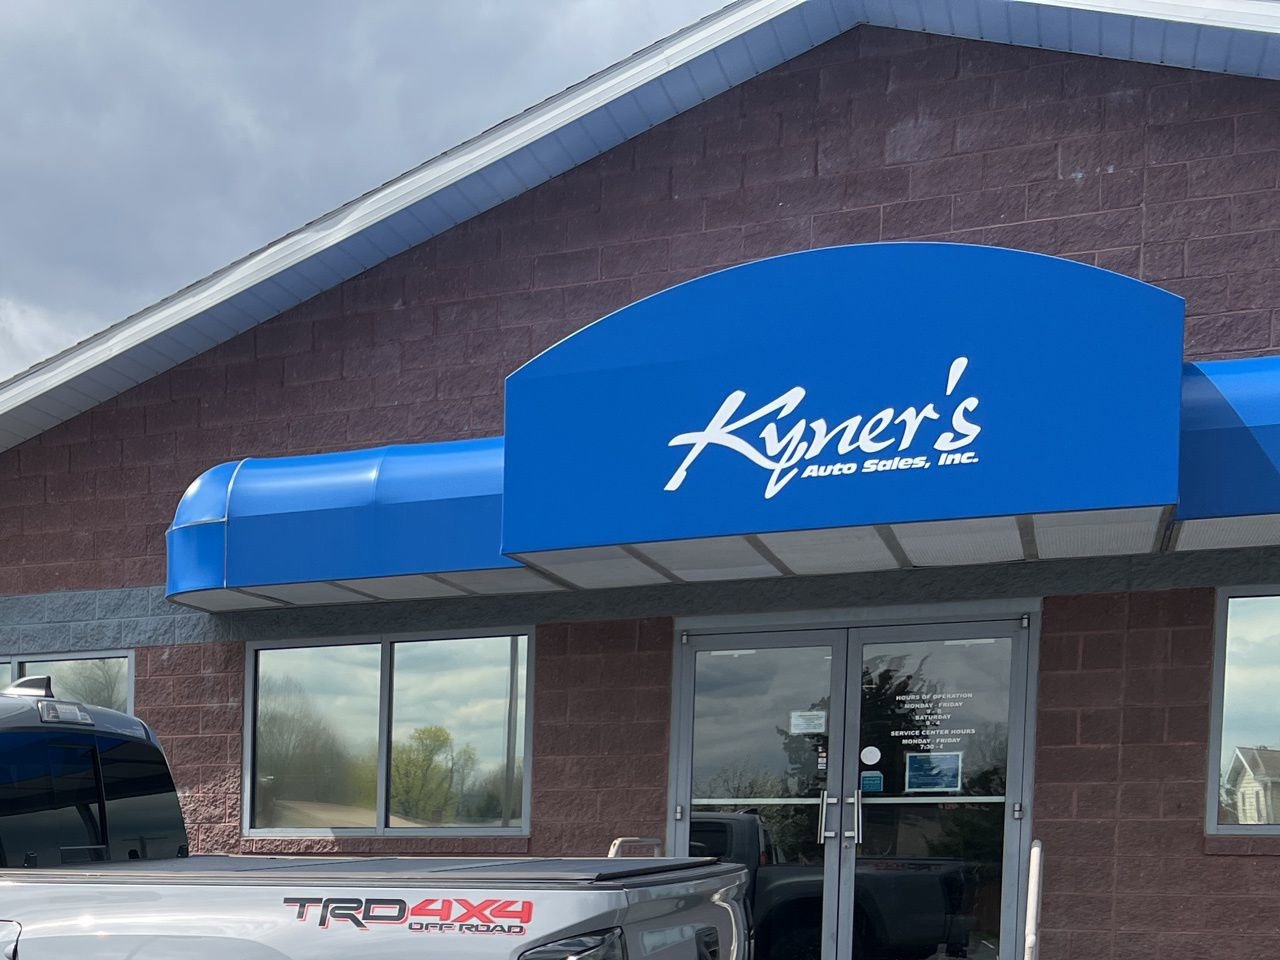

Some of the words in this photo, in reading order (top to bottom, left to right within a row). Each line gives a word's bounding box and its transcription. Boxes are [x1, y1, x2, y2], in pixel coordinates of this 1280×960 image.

[664, 356, 982, 500] Kyner's
[800, 462, 857, 478] Auto
[861, 456, 931, 473] Sales,
[937, 451, 980, 466] Inc.
[408, 922, 456, 934] OFF
[457, 923, 527, 936] ROAD
